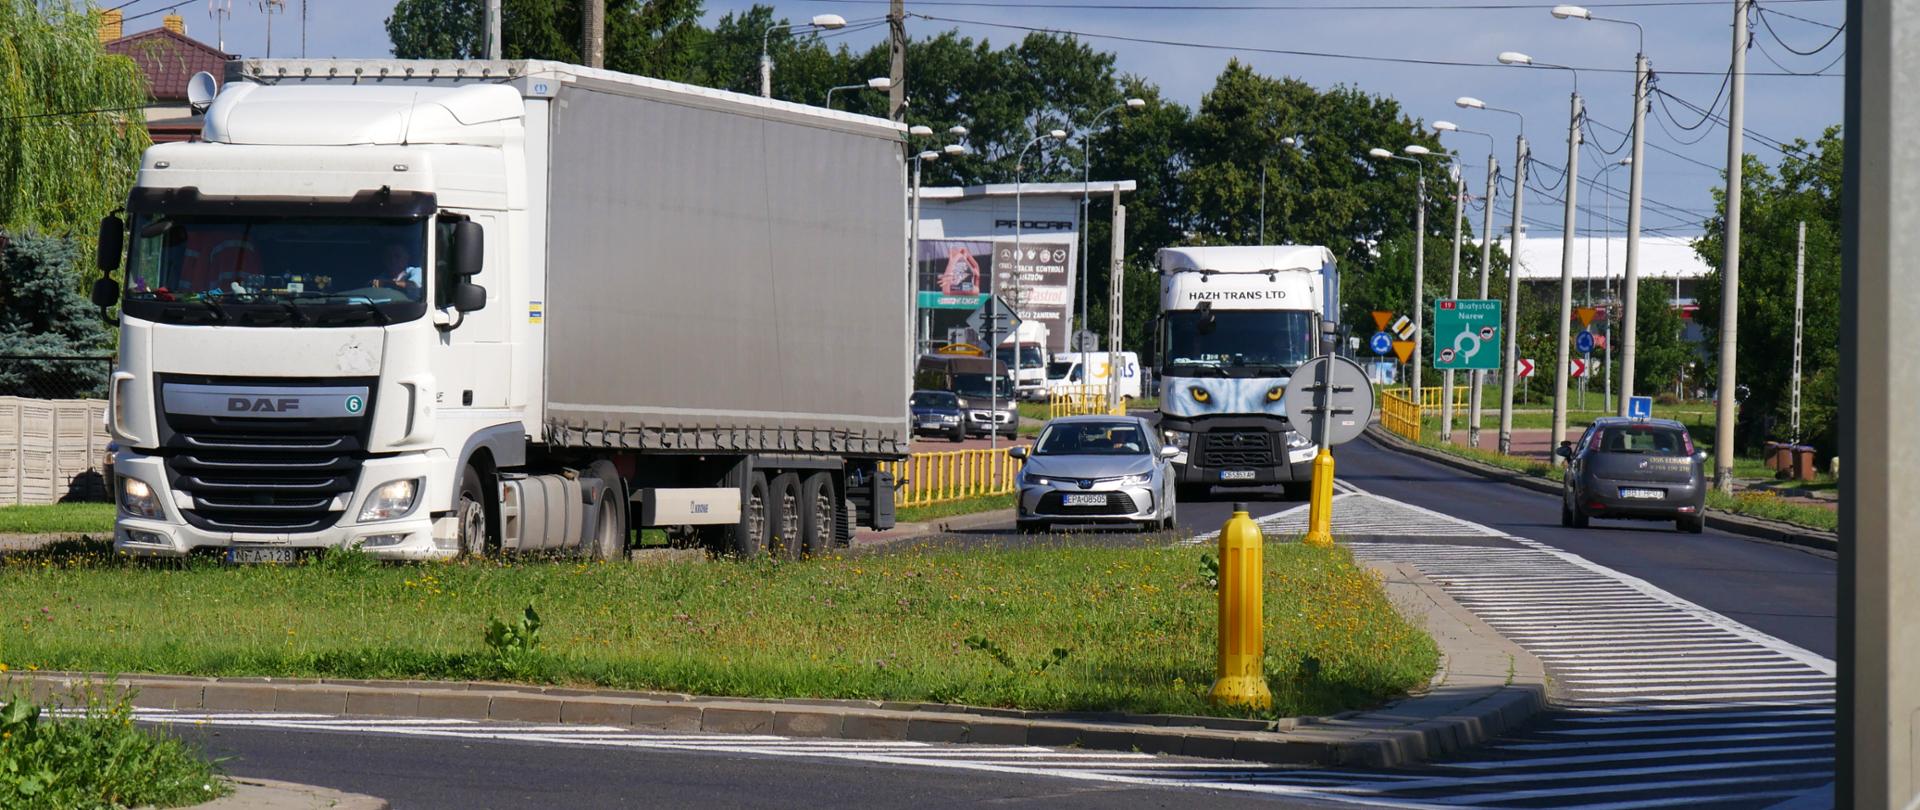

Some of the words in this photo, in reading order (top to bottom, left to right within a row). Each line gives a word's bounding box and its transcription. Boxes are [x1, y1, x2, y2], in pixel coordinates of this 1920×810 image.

[995, 219, 1073, 230] PROCAR
[1188, 291, 1220, 300] HAZH
[1223, 291, 1262, 299] TRANS
[1265, 290, 1286, 299] LTD
[1458, 302, 1495, 311] Białystok
[1458, 312, 1484, 320] Narew
[227, 397, 300, 412] DAF
[349, 398, 359, 411] 6
[1634, 400, 1645, 415] L
